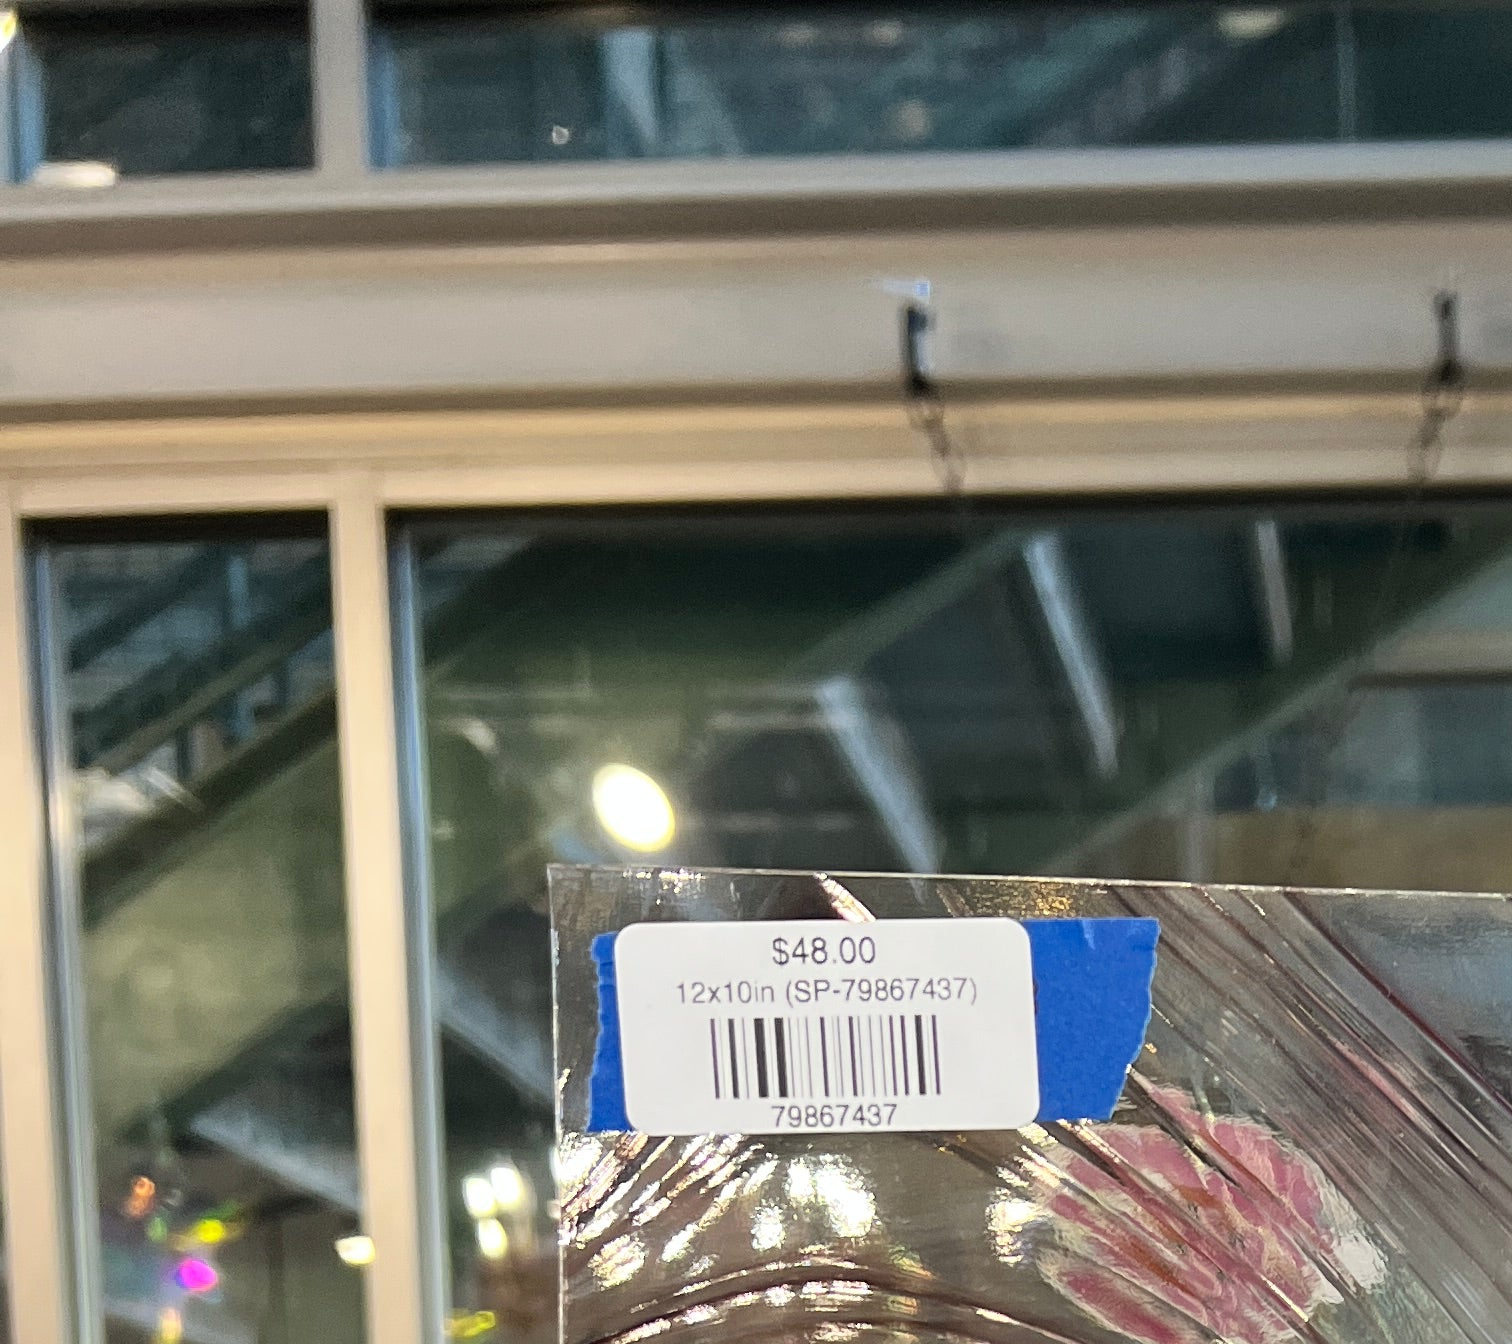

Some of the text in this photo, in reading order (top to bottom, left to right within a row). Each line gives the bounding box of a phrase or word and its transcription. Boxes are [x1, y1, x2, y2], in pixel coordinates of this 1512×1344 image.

[772, 936, 877, 967] $48.00
[677, 977, 978, 1006] 12x10in (SP-79867437)
[771, 1103, 898, 1128] 79867437
